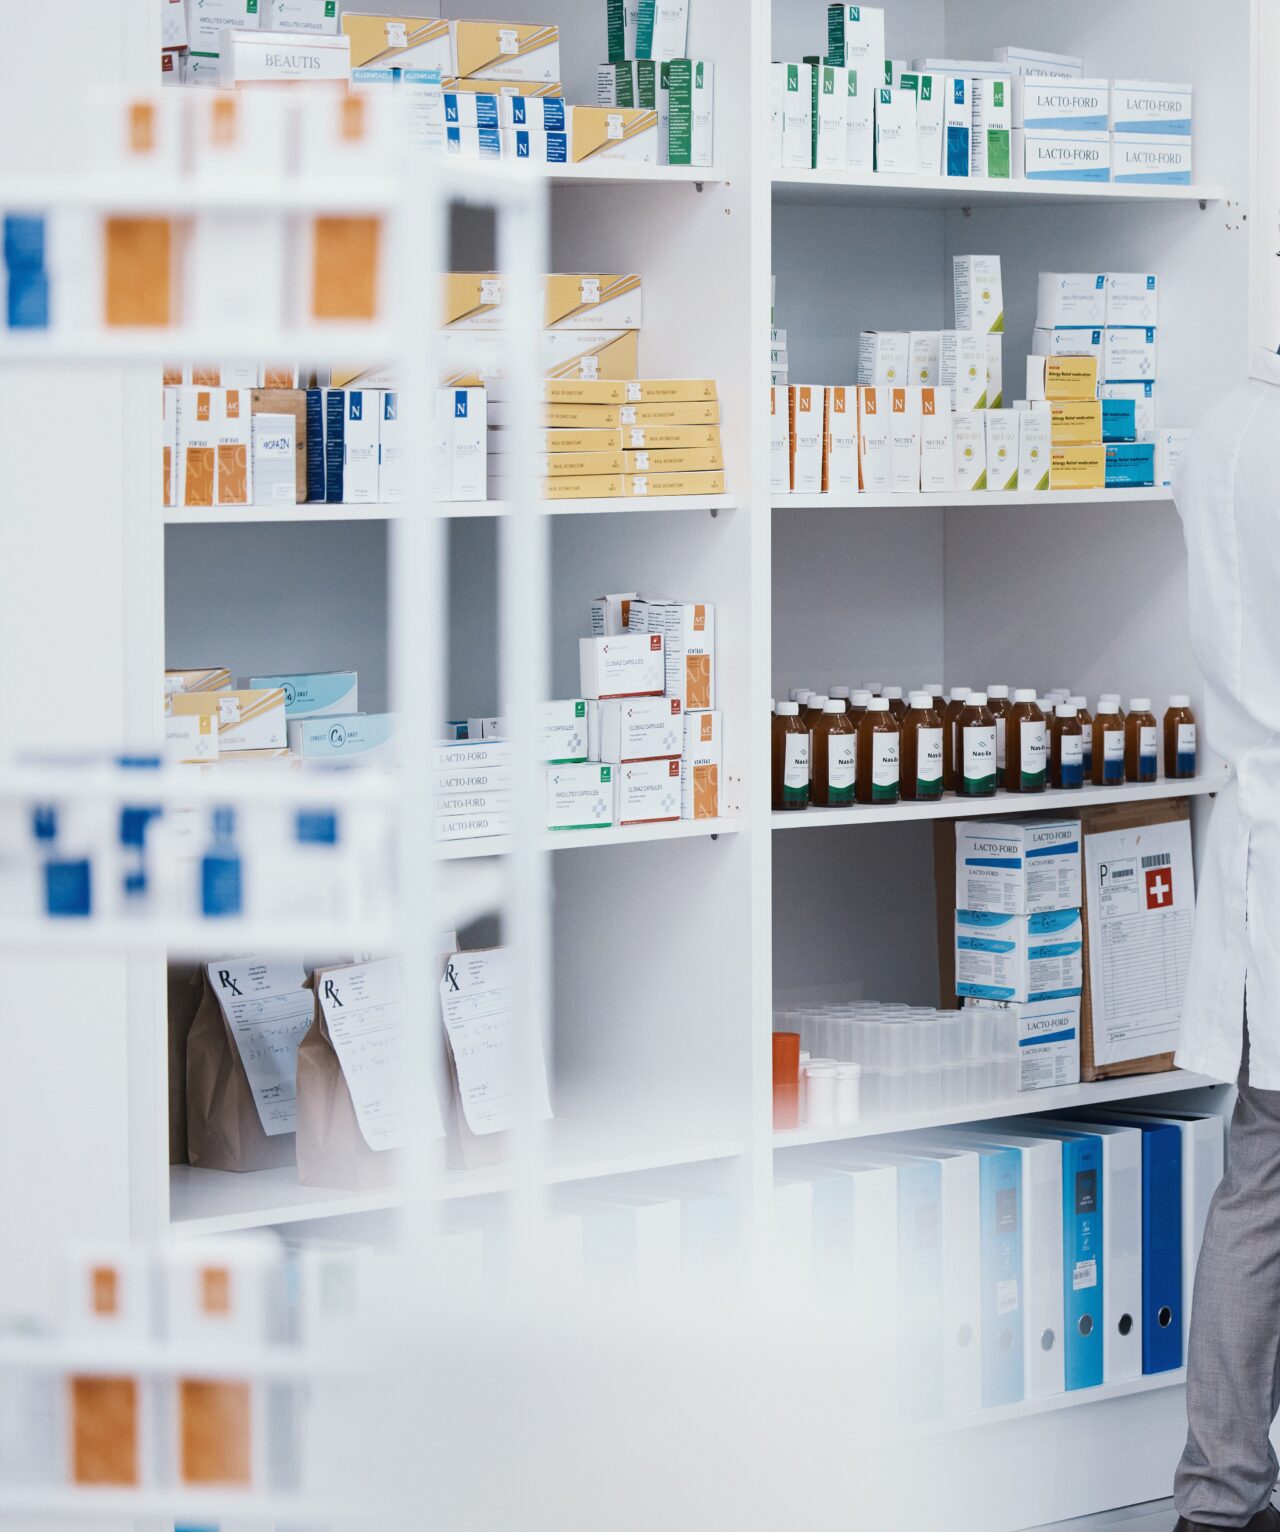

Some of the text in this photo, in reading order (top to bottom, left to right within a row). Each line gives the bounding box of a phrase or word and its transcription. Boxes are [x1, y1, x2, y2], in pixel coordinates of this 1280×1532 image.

[265, 54, 321, 69] BEAUTIS
[1037, 95, 1098, 108] LACTO-FORD
[1127, 99, 1182, 112] LACTO-FORD
[1038, 148, 1099, 161] LACTO-FORD
[1126, 151, 1182, 164] LACTO-FORD
[457, 403, 465, 414] N
[866, 401, 874, 411] N
[895, 399, 903, 408] N
[925, 402, 932, 412] N
[351, 406, 359, 417] N
[440, 751, 487, 763] LACTO-FORD
[440, 776, 488, 787] LACTO-FORD
[437, 798, 486, 809] LACTO-FORD
[443, 819, 488, 832] LACTO-FORD
[1032, 831, 1072, 842] LACTO-FORD
[974, 843, 1018, 854] LACTO-FORD
[1100, 865, 1108, 886] P
[1027, 1018, 1069, 1030] LACTO-FORD
